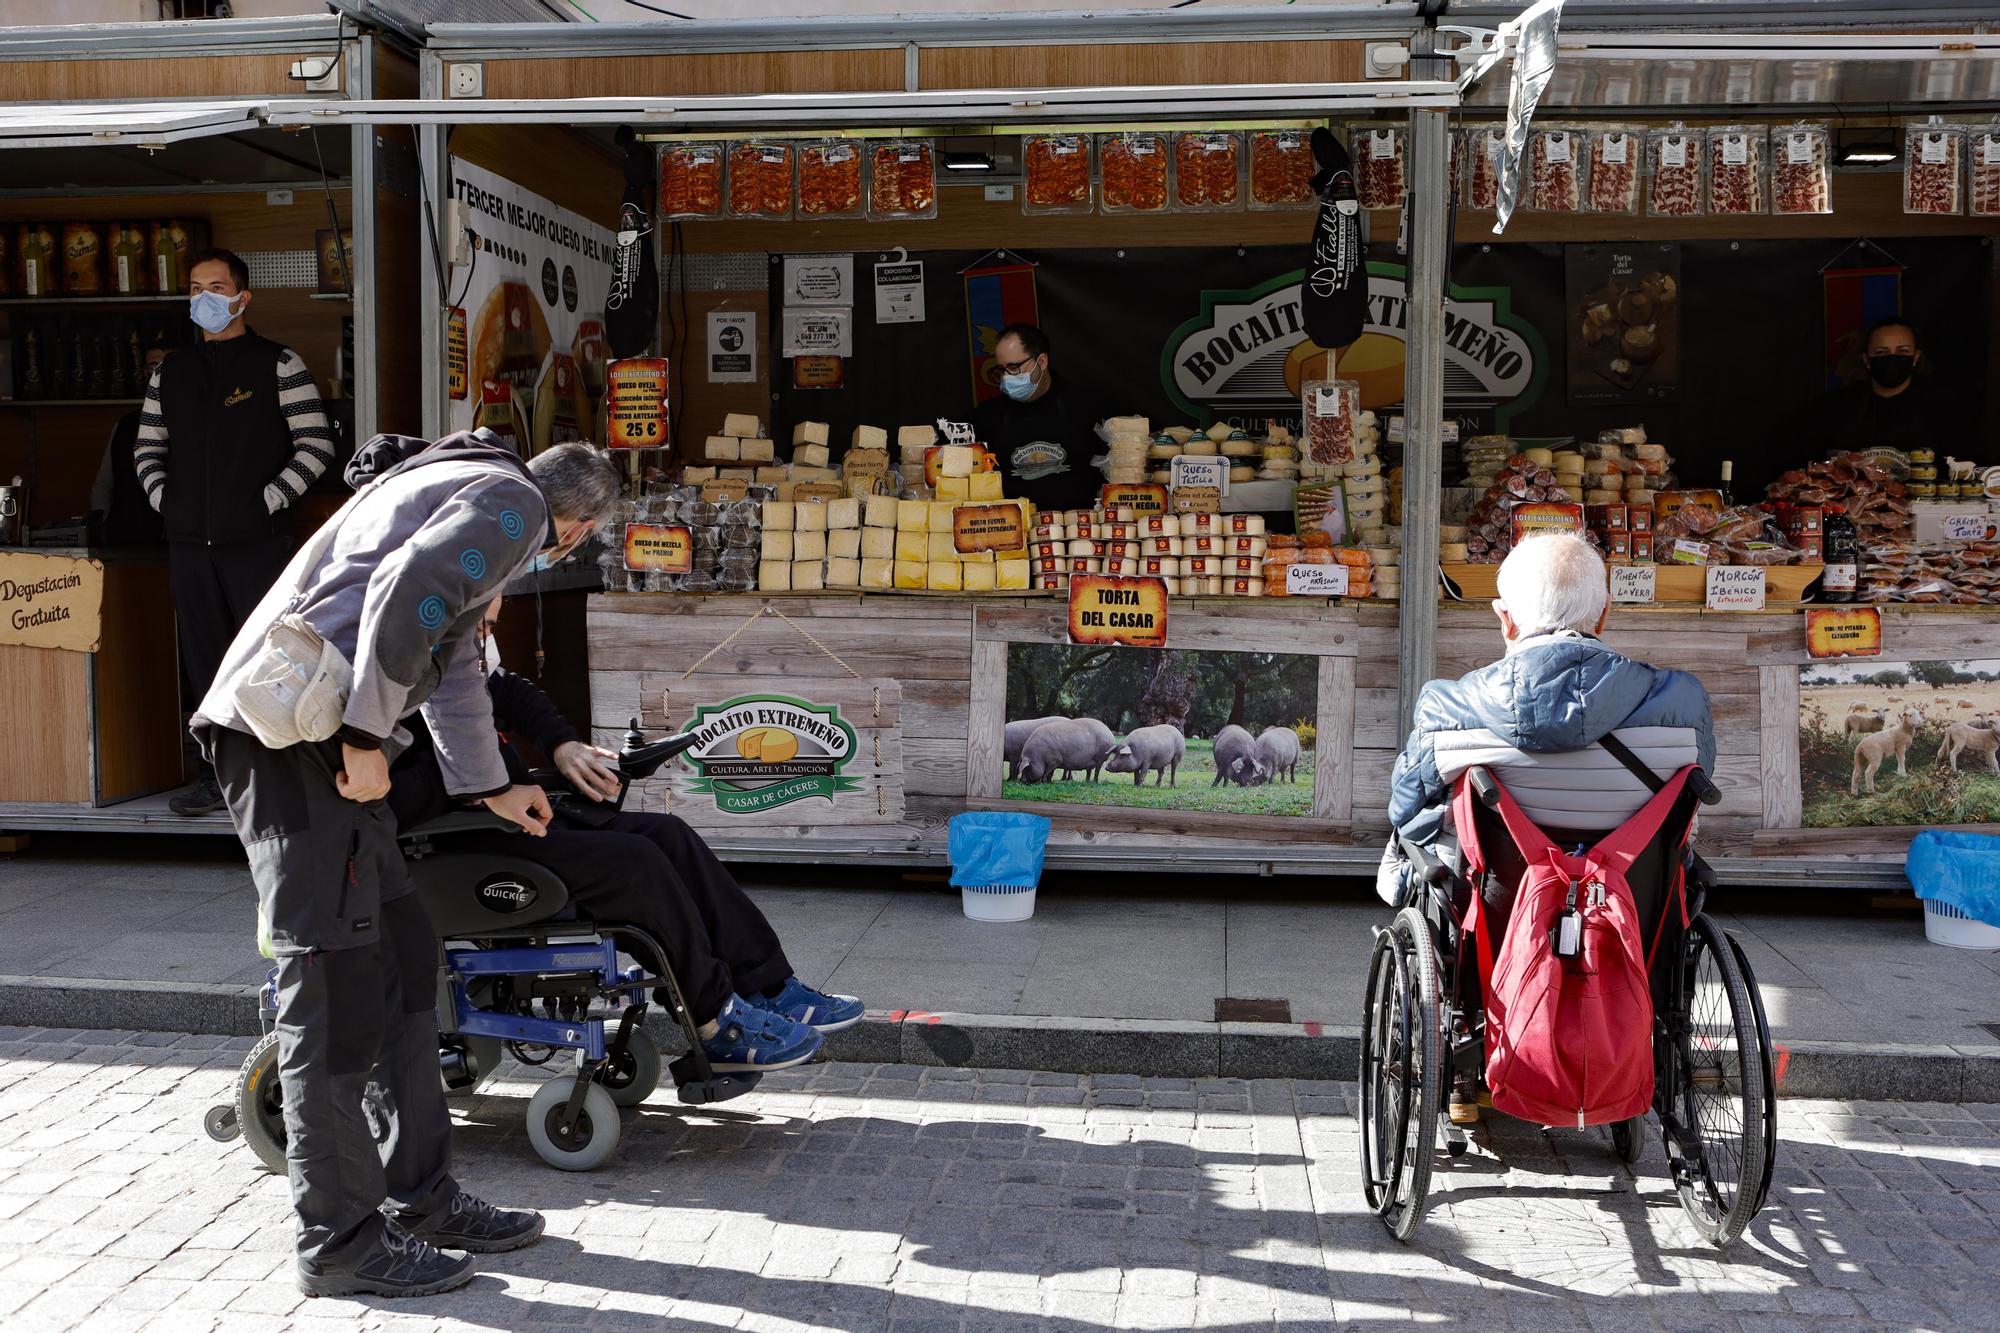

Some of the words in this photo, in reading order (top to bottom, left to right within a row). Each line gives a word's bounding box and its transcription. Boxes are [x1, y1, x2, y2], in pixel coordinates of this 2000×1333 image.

[456, 178, 504, 221] TERCER
[507, 201, 547, 238] MEJOR
[548, 219, 580, 253] QUESO
[582, 235, 599, 261] DEL
[1338, 213, 1346, 270] EXTREMADU
[1612, 267, 1633, 275] Casar
[1182, 300, 1303, 385] BOCAÍT
[626, 422, 643, 436] 25
[647, 422, 656, 436] €
[1182, 465, 1213, 474] QUESO
[1181, 475, 1213, 484] TETILLA
[1136, 502, 1161, 510] NEGRA
[987, 517, 1006, 525] FUERTE
[987, 524, 1017, 533] EXTREMEÑO
[1292, 568, 1323, 579] QUESO
[1615, 568, 1653, 580] PIMENTÓN
[1715, 569, 1763, 582] MORCÓN
[0, 570, 81, 602] Degustación
[1630, 588, 1650, 596] VERA
[1097, 589, 1140, 605] TORTA
[12, 604, 70, 630] Gratuita
[1081, 611, 1105, 627] DEL
[1109, 612, 1154, 628] CASAR
[692, 710, 753, 752] BOCAÍTO
[757, 709, 845, 750] EXTREMEÑO
[752, 764, 773, 773] ARTE
[774, 764, 781, 773] Y
[782, 763, 828, 773] TRADICIÓN
[727, 796, 759, 809] CASAR
[762, 792, 775, 804] DE
[777, 780, 819, 800] CÁCERES
[483, 887, 526, 902] QUICKIE
